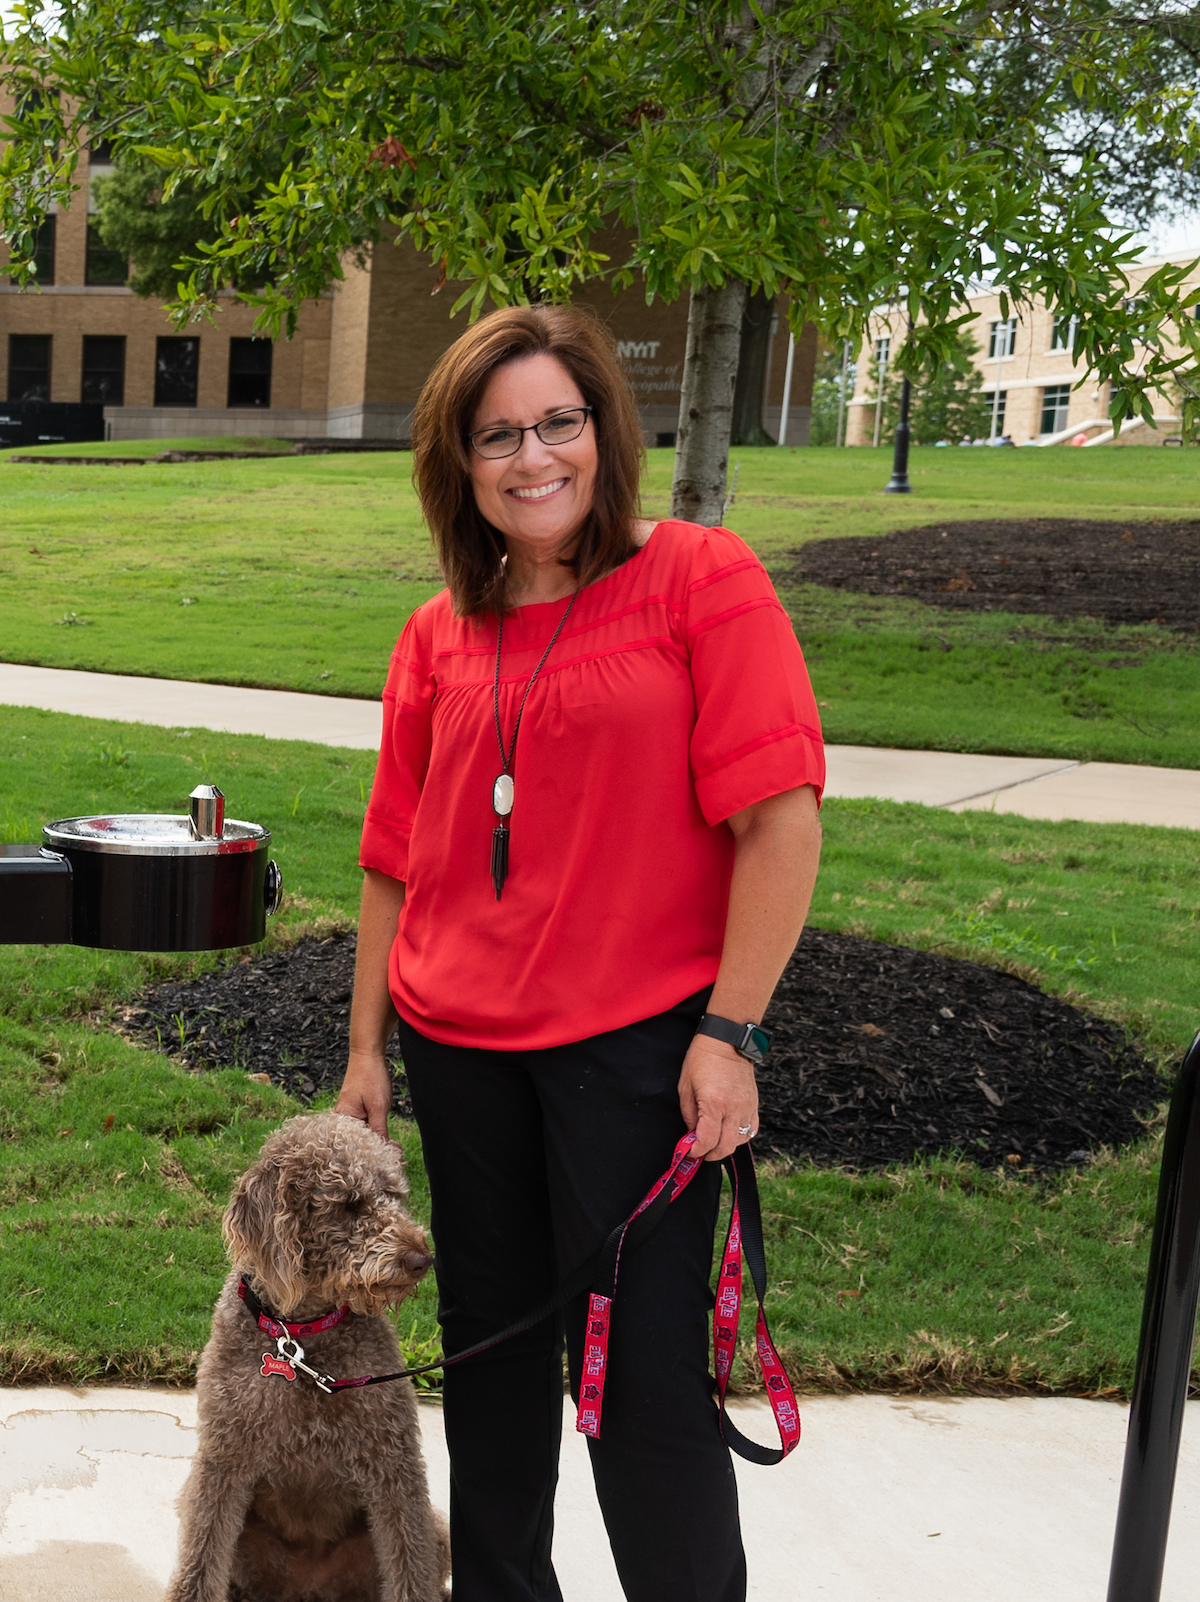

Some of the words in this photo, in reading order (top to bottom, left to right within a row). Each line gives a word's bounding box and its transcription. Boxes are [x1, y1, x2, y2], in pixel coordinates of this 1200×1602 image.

[623, 362, 662, 377] ollege
[718, 1286, 739, 1318] STATE
[268, 1361, 290, 1372] MAPLE
[586, 1345, 605, 1375] STATE
[777, 1400, 797, 1433] STATE
